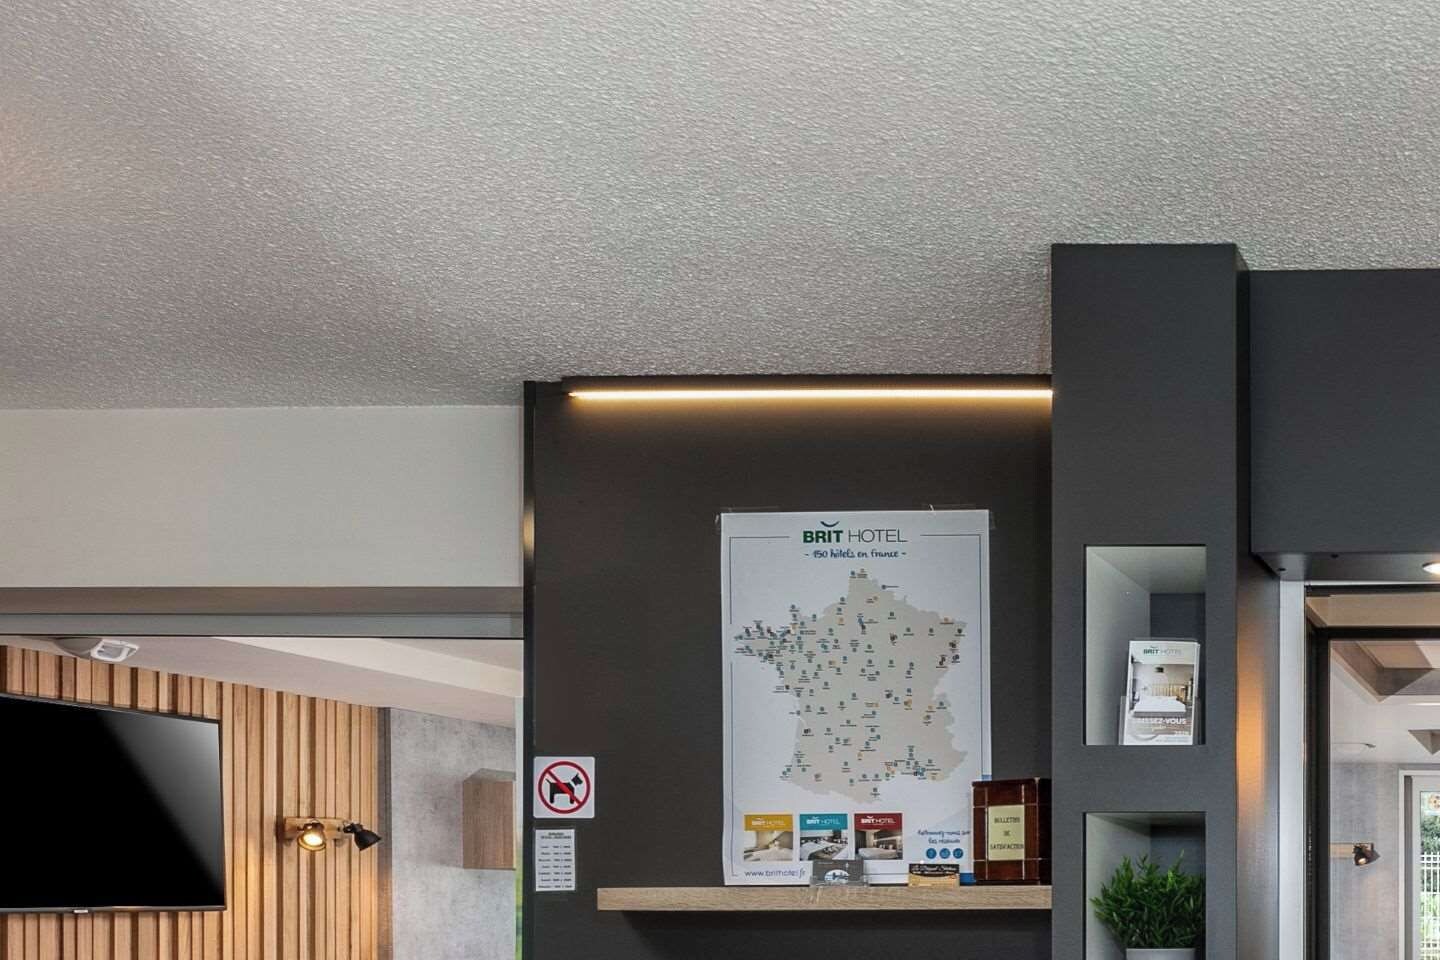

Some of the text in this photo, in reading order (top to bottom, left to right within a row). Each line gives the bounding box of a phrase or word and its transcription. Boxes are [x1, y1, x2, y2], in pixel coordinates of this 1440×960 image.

[803, 529, 908, 543] BRIT HOTEL
[813, 550, 828, 558] 150
